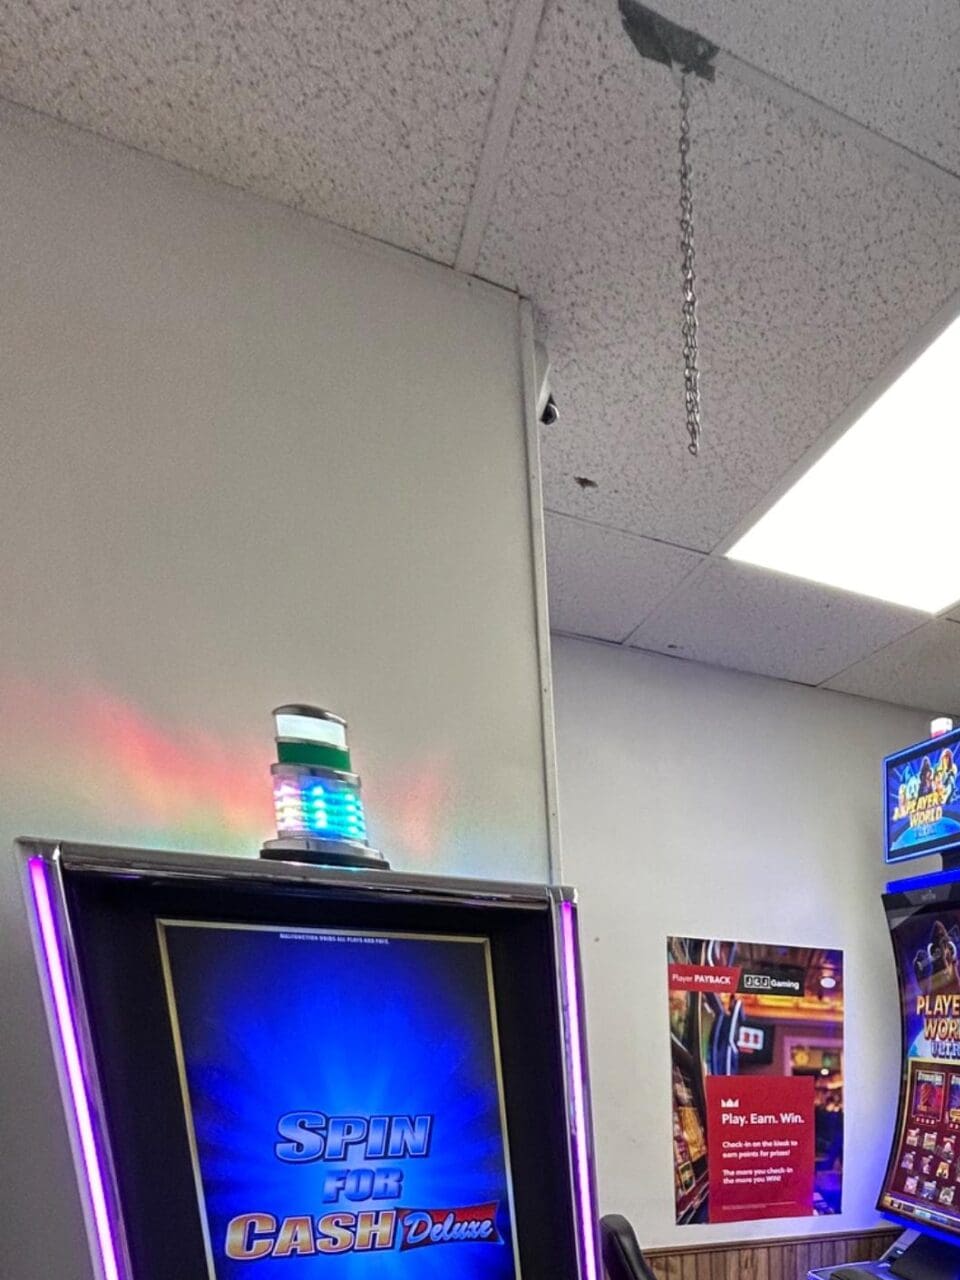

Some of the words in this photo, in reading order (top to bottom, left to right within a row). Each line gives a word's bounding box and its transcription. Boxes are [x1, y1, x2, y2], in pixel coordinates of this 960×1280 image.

[910, 806, 942, 828] WORLD
[672, 973, 693, 983] Player
[694, 974, 731, 985] PAYBACK
[770, 979, 800, 990] Gaming
[722, 1113, 749, 1127] Play.
[750, 1113, 779, 1125] Earn.
[780, 1112, 805, 1124] Win.
[275, 1112, 433, 1163] SPIN
[322, 1168, 403, 1202] FOR
[225, 1211, 397, 1260] CASH
[403, 1210, 494, 1245] Deluxe
